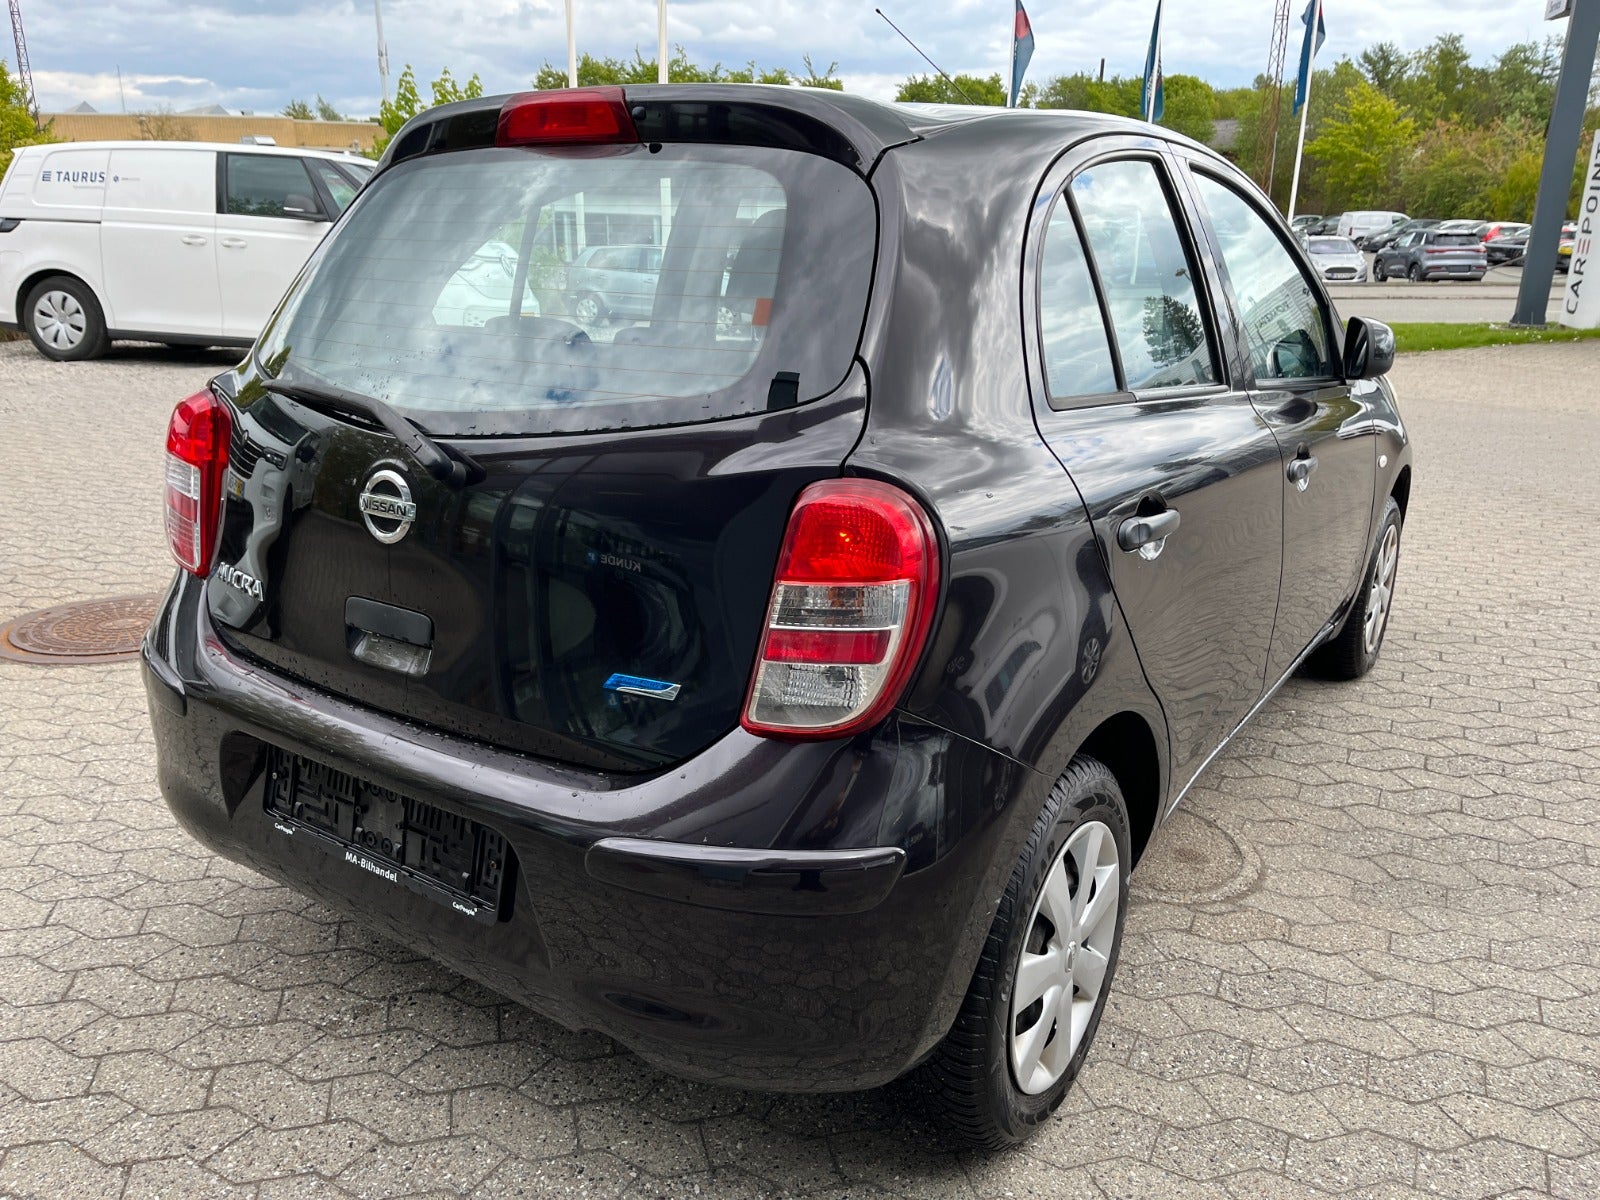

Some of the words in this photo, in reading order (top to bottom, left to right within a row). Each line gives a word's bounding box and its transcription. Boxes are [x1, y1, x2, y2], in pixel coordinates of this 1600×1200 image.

[56, 171, 106, 183] TAURUS
[362, 497, 407, 517] NISSAN
[217, 561, 264, 602] MICRA
[345, 851, 398, 883] MA-Bilhandel
